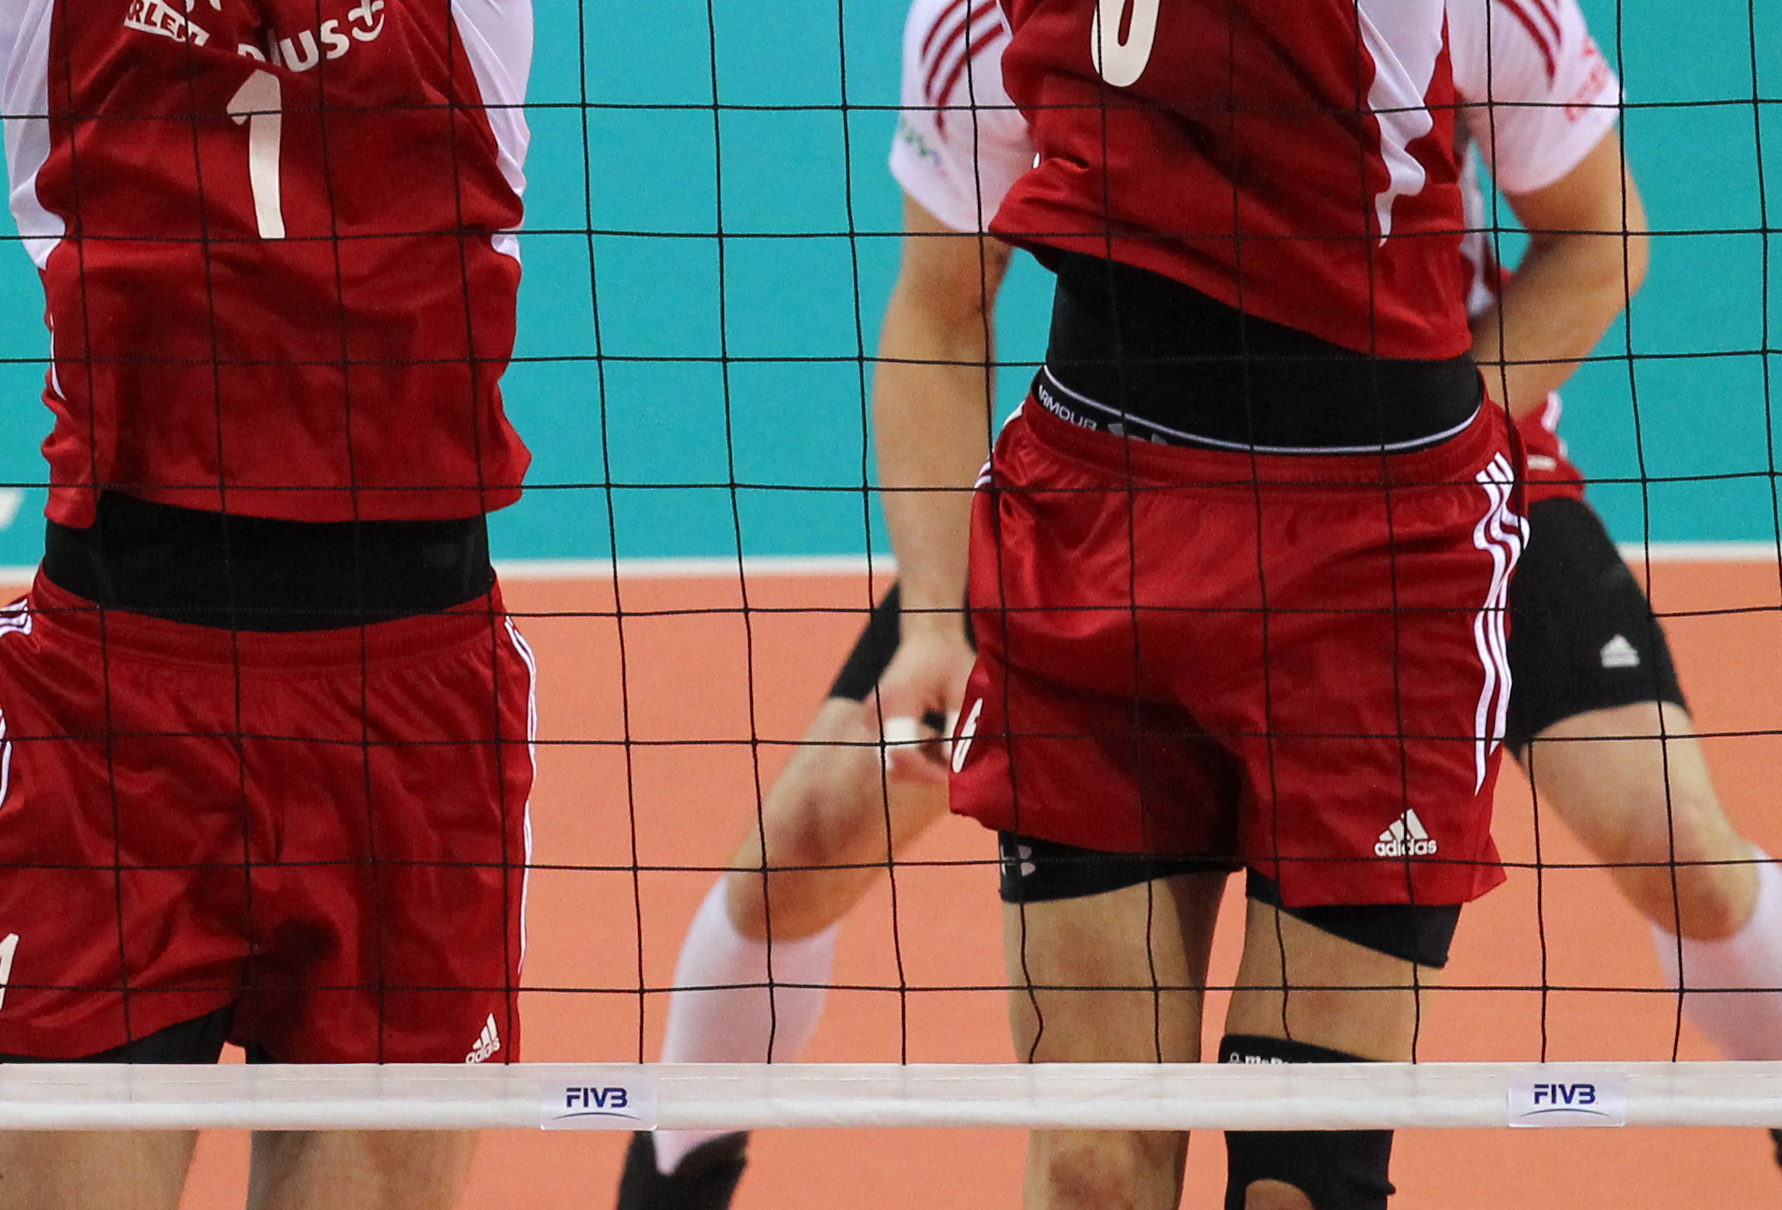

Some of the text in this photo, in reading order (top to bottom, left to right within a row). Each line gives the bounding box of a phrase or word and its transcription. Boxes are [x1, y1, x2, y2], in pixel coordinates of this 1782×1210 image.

[226, 68, 286, 239] 1
[1374, 839, 1437, 857] adidas
[565, 1087, 628, 1108] FIVB
[1533, 1083, 1596, 1106] FIVB
